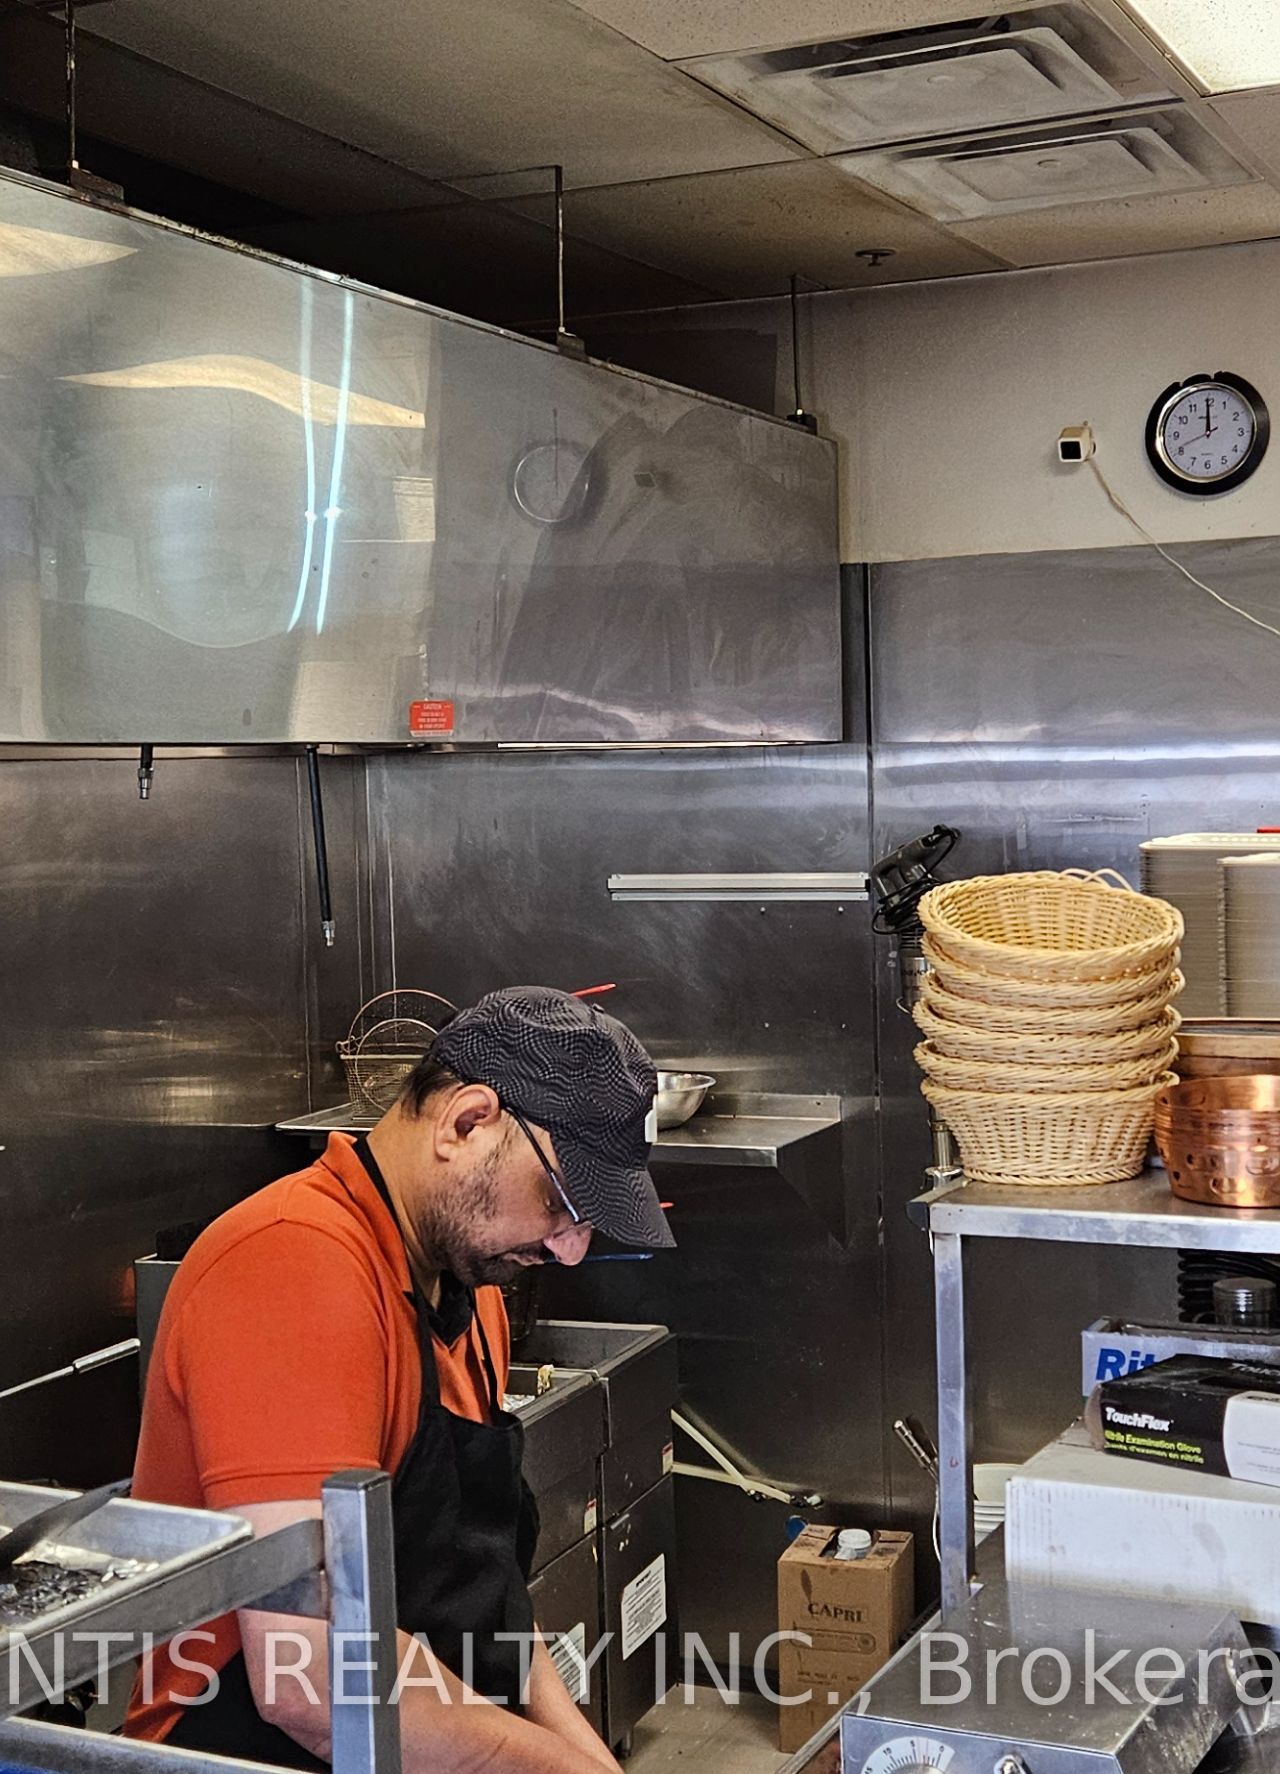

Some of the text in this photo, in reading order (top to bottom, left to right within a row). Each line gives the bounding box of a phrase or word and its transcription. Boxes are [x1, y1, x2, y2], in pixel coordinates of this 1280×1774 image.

[1188, 403, 1197, 413] 11
[1222, 401, 1227, 409] 1
[1178, 415, 1188, 425] 10
[1233, 412, 1239, 421] 2
[1173, 431, 1180, 440] 9
[1237, 427, 1244, 436] 3
[1178, 446, 1184, 456] 8
[1232, 444, 1238, 453] 4
[1190, 457, 1197, 466] 7
[1204, 460, 1211, 470] 6
[1221, 455, 1228, 465] 5
[1105, 1406, 1171, 1432] TouchFlex
[1176, 1442, 1202, 1454] Glove
[807, 1602, 864, 1624] CAPRI
